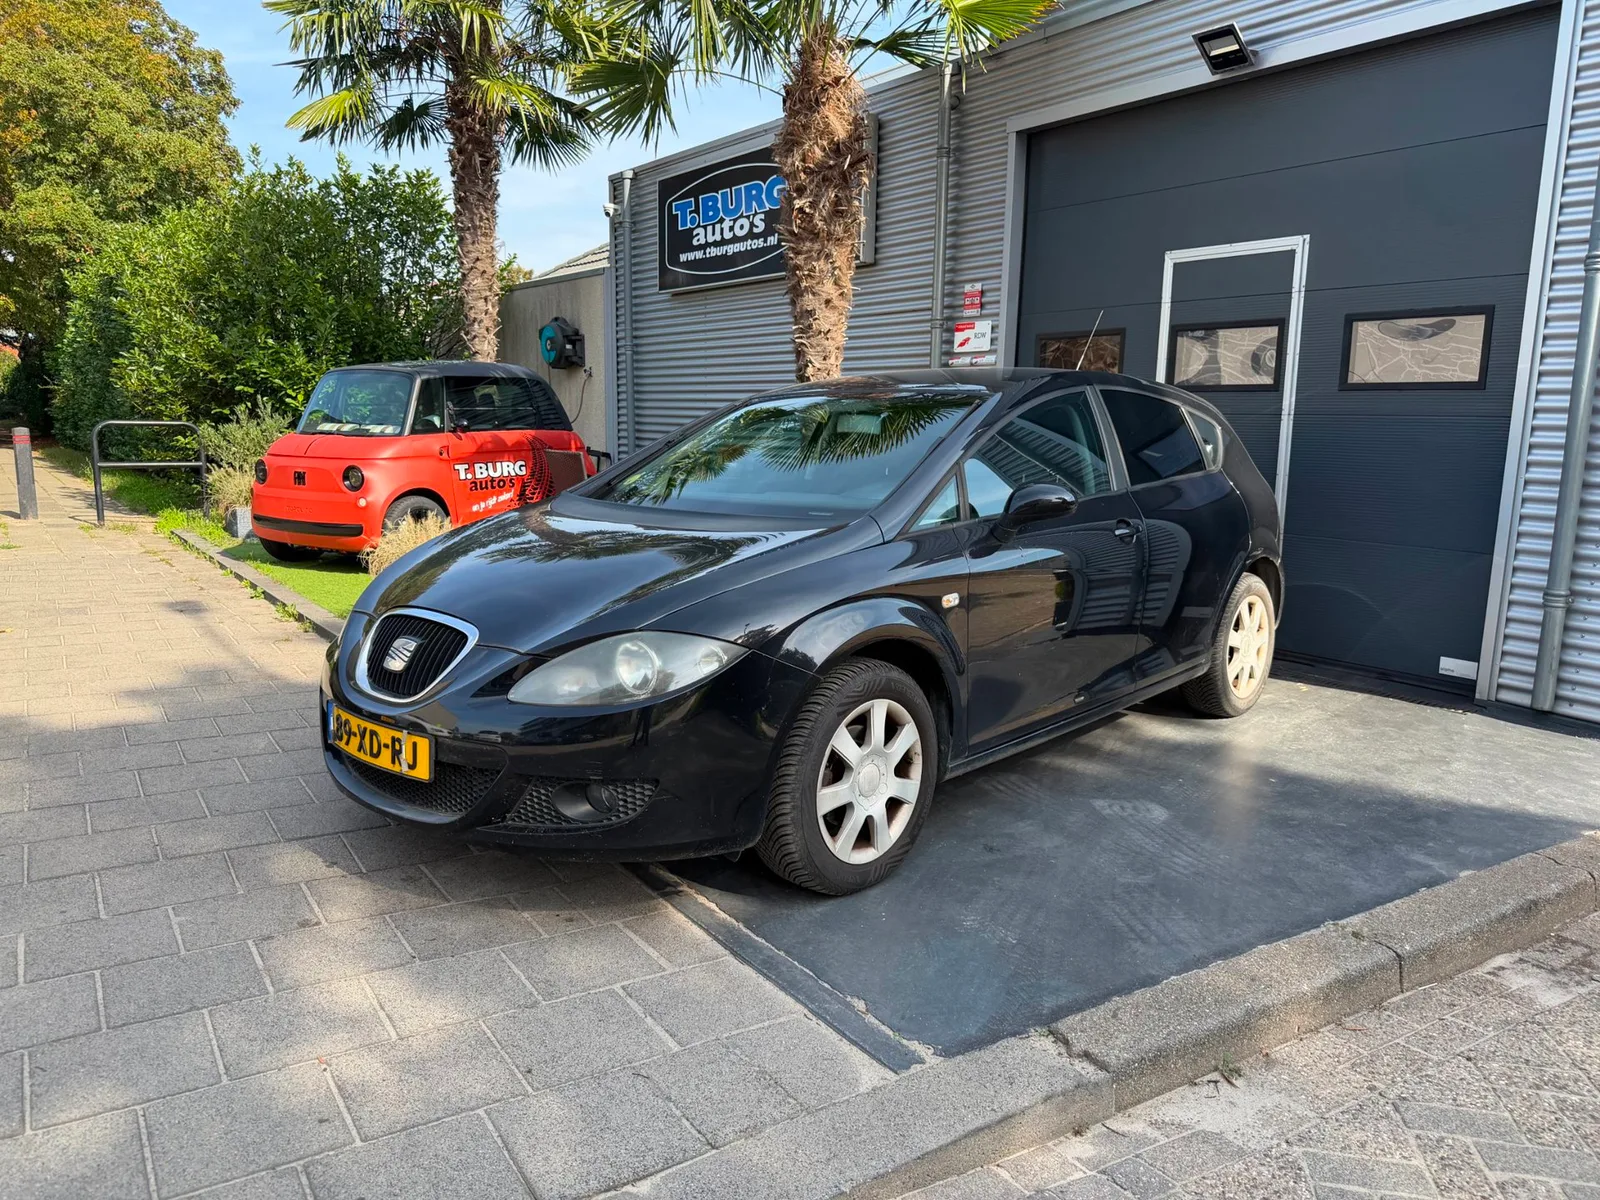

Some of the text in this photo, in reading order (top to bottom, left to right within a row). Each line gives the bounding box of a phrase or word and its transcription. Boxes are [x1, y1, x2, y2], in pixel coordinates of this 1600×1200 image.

[692, 213, 765, 245] auto's
[679, 233, 778, 262] www.tburgautos.nl
[469, 477, 516, 492] auto's
